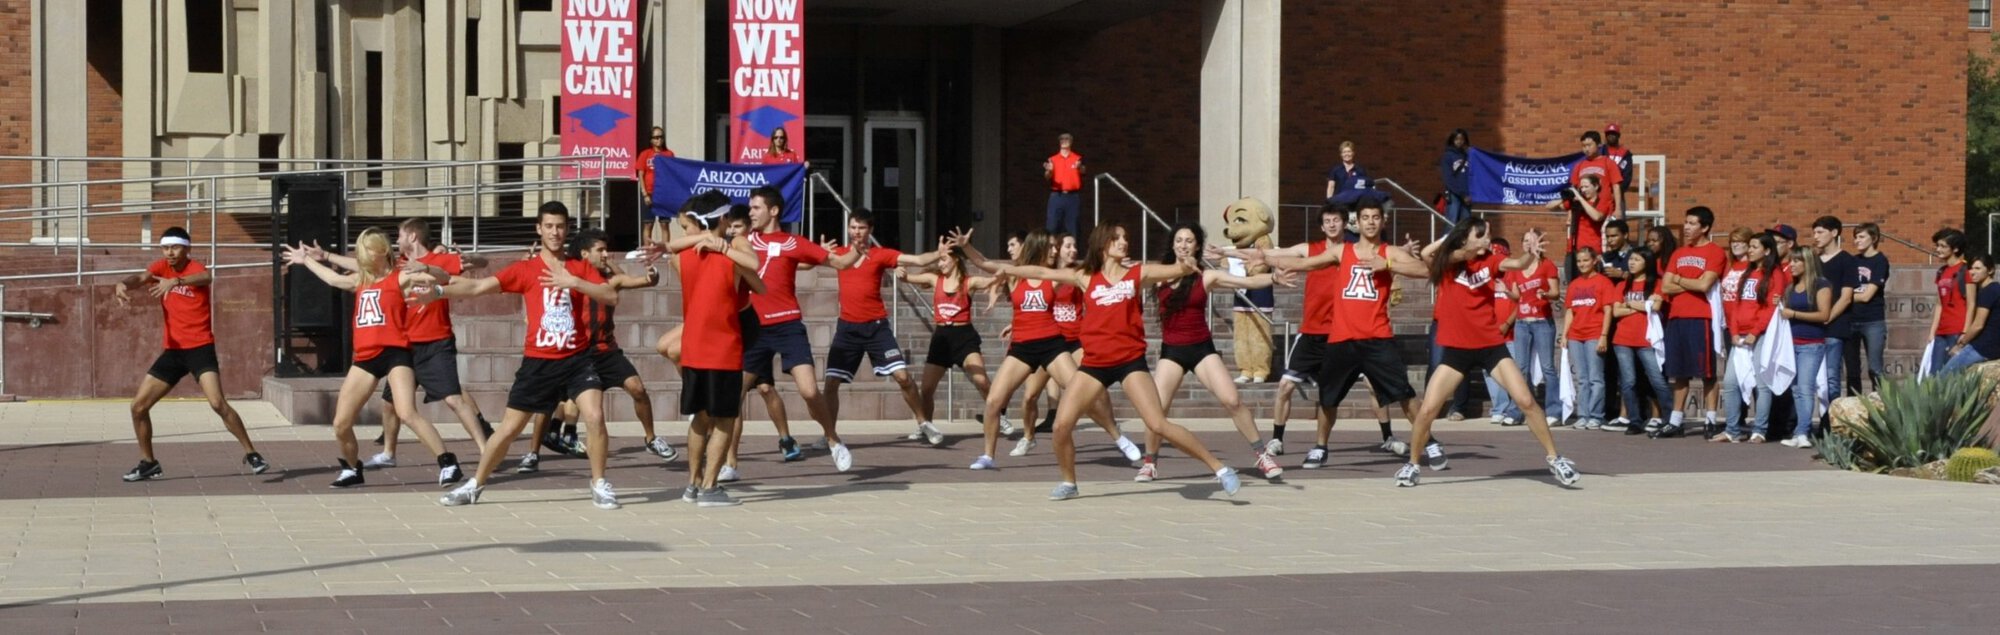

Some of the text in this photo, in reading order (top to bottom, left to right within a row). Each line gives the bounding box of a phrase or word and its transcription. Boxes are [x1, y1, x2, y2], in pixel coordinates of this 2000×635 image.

[566, 0, 629, 18] NOW
[735, 0, 796, 21] NOW
[564, 19, 633, 63] WE
[732, 22, 800, 65] WE
[564, 63, 634, 99] CAN!
[733, 66, 800, 100] CAN!
[571, 144, 628, 158] ARIZONA
[697, 167, 766, 185] ARIZONA
[1505, 161, 1566, 174] ARIZONA
[1507, 174, 1569, 186] assurance
[1342, 264, 1379, 301] A
[356, 288, 387, 329] A
[1020, 288, 1048, 312] A
[535, 327, 578, 351] LOVE
